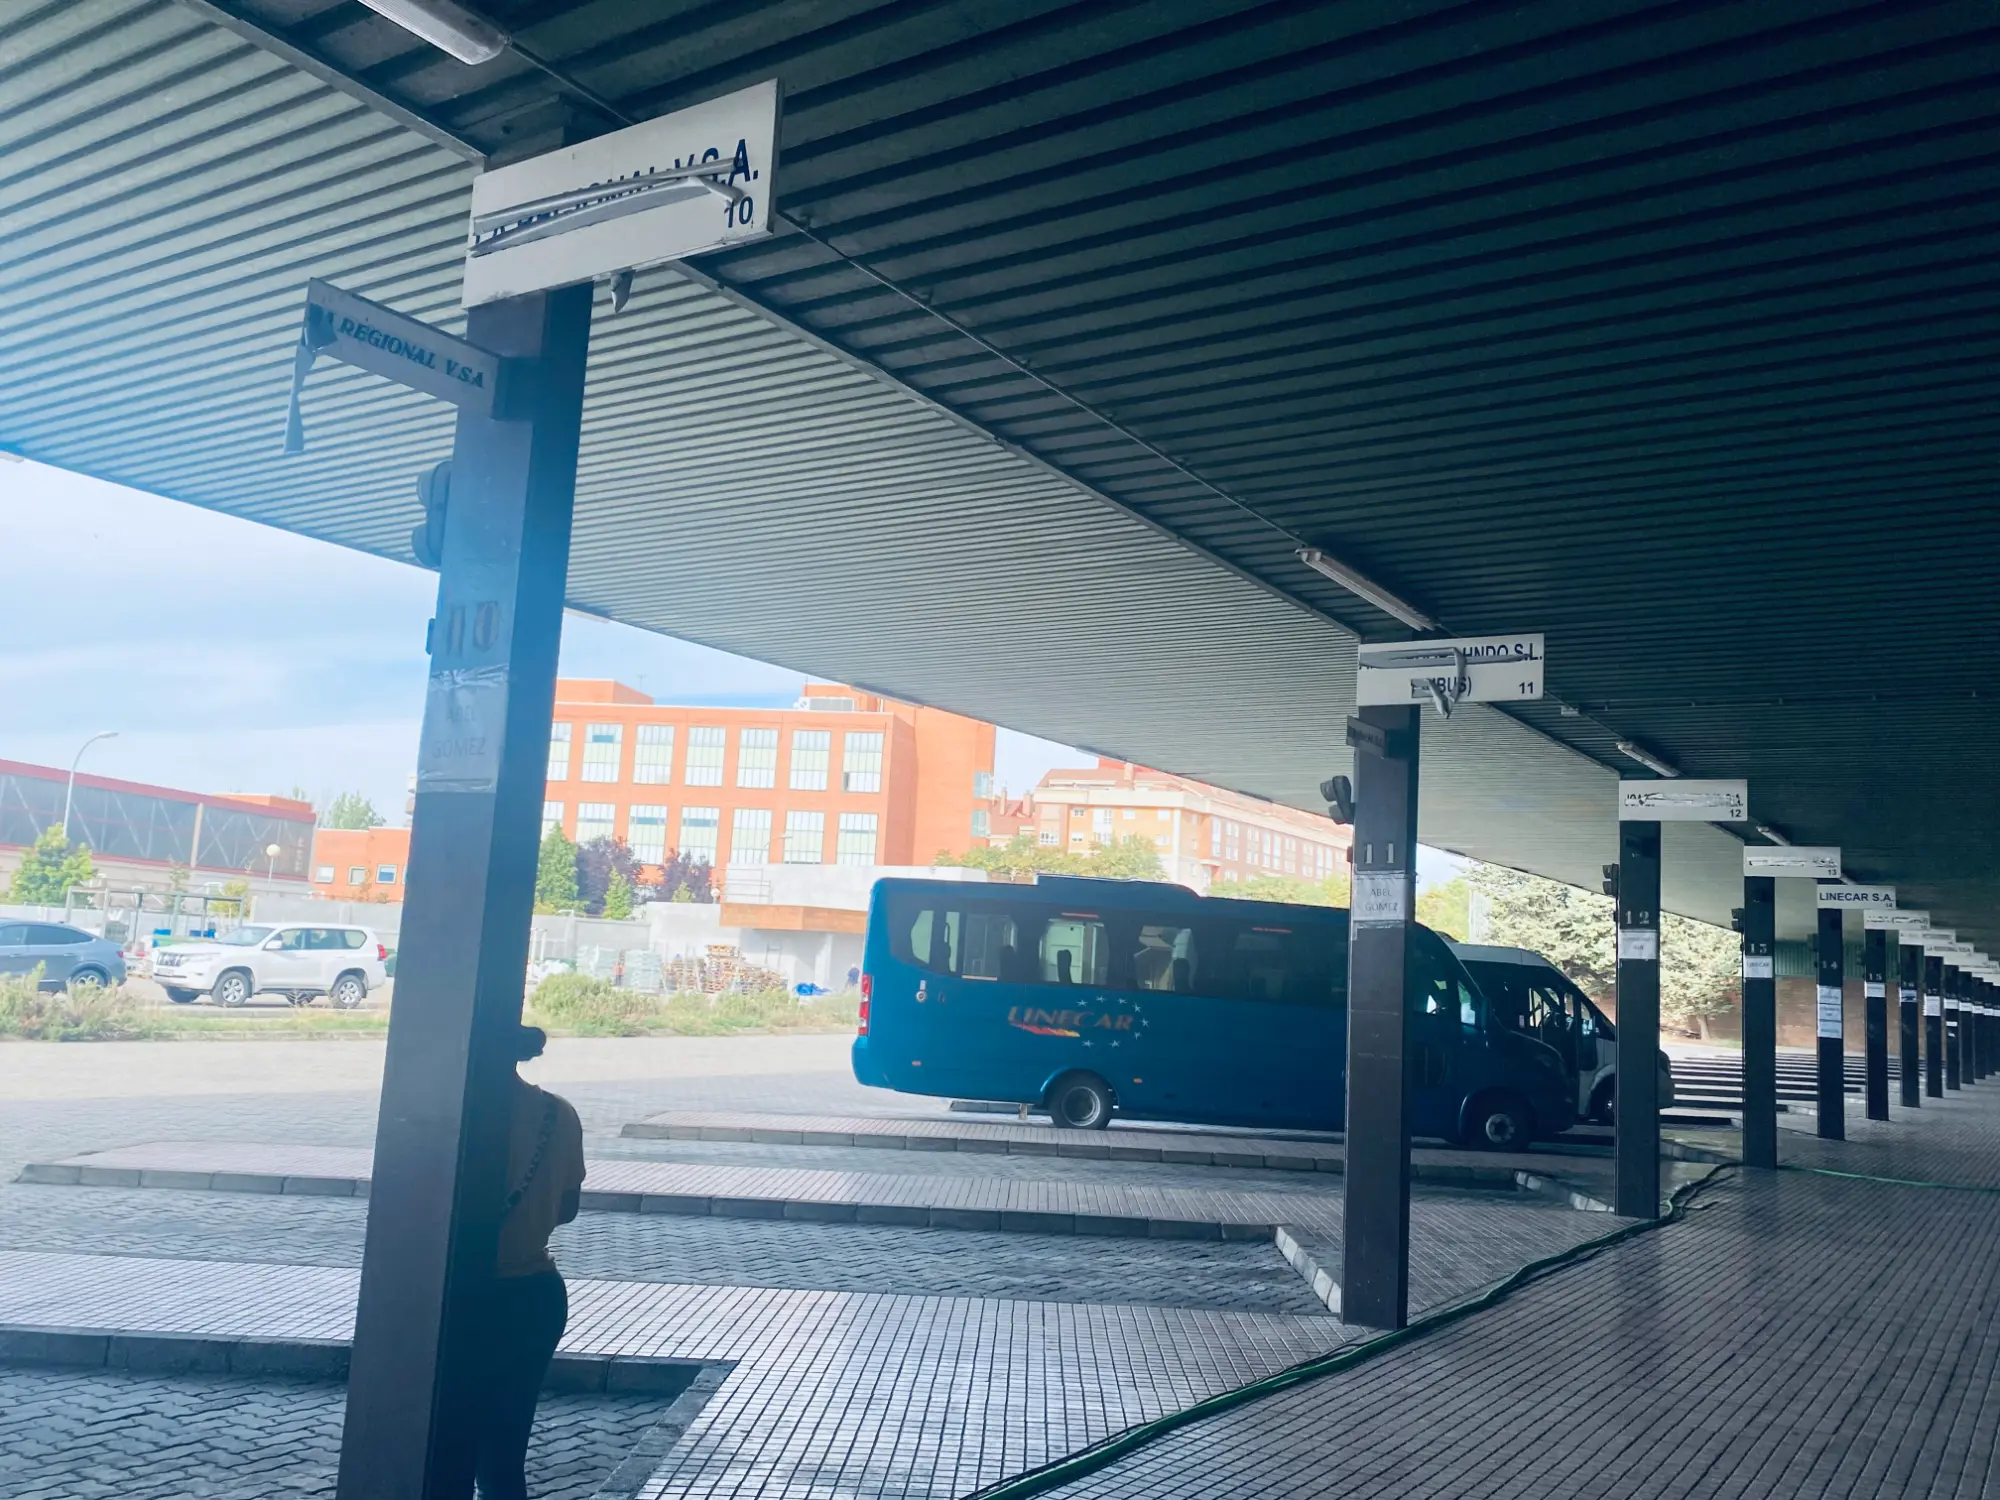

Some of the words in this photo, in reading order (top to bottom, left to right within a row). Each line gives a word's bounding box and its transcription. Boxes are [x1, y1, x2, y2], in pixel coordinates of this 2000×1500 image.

[724, 196, 754, 228] 10
[336, 316, 436, 370] REGIONAL
[1519, 682, 1534, 694] 11
[432, 736, 486, 758] GOMEZ
[1729, 808, 1742, 818] 12
[1365, 843, 1395, 864] 11
[1827, 868, 1838, 876] 13
[1370, 887, 1393, 897] ABEL
[1819, 892, 1869, 902] LINECAR
[1625, 911, 1650, 925] 12
[1007, 1006, 1134, 1030] LINECAR
